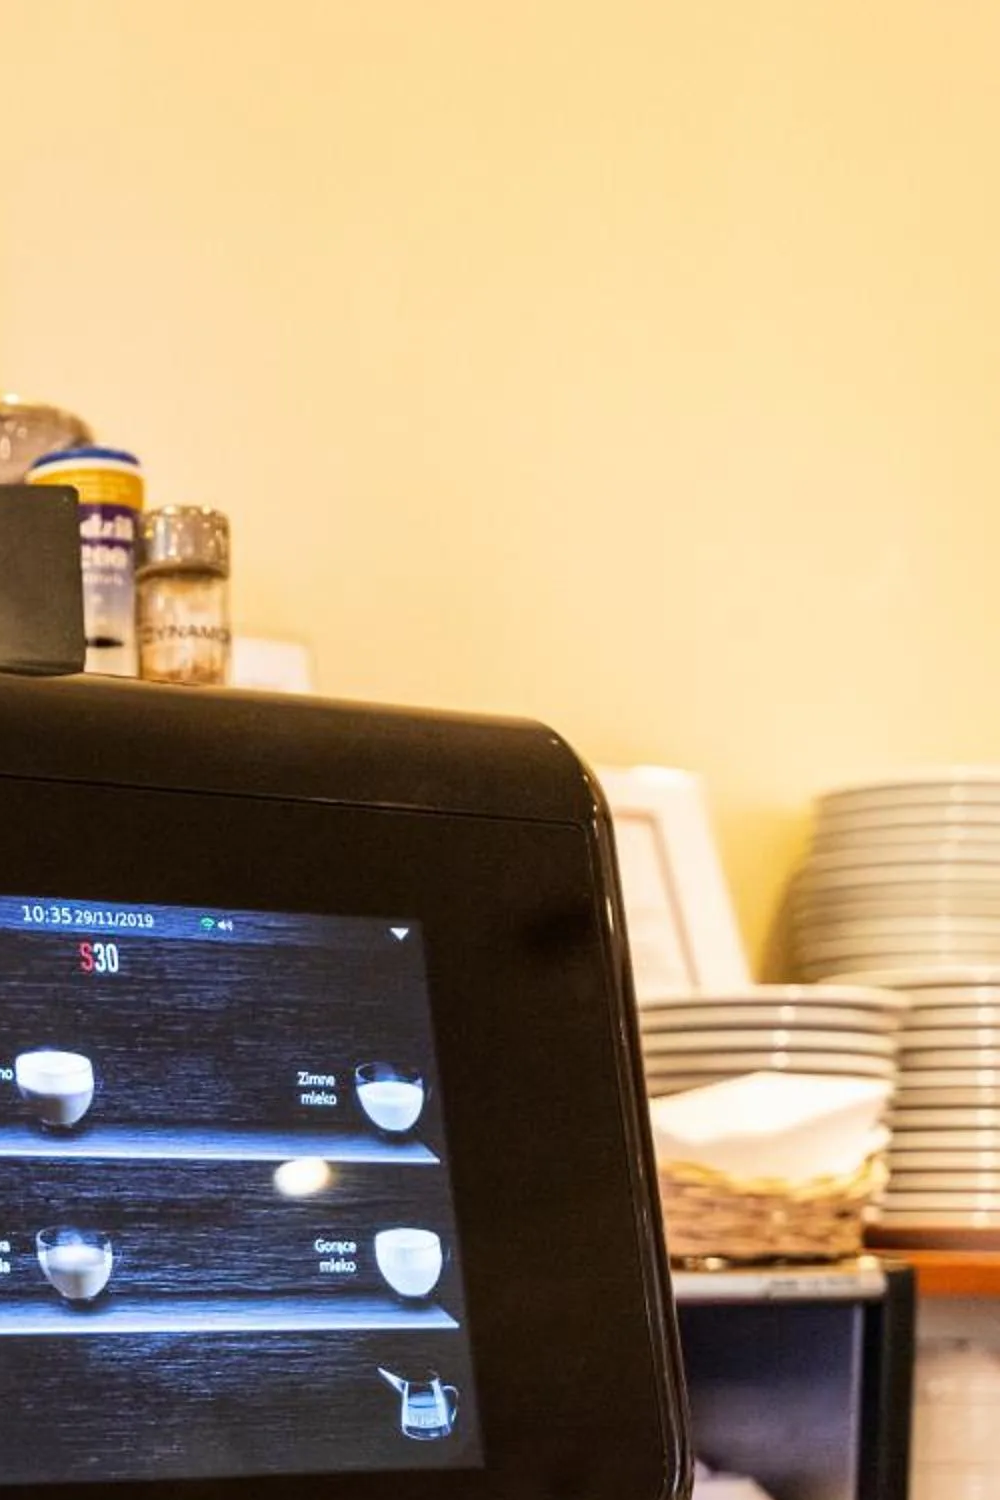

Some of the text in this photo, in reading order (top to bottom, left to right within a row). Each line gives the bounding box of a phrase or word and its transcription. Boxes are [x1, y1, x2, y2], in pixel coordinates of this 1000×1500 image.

[21, 904, 155, 929] 10:35 29/11/2019
[79, 942, 119, 974] S30
[297, 1071, 336, 1086] Zimne
[301, 1091, 337, 1105] mleko
[319, 1257, 357, 1273] mleko
